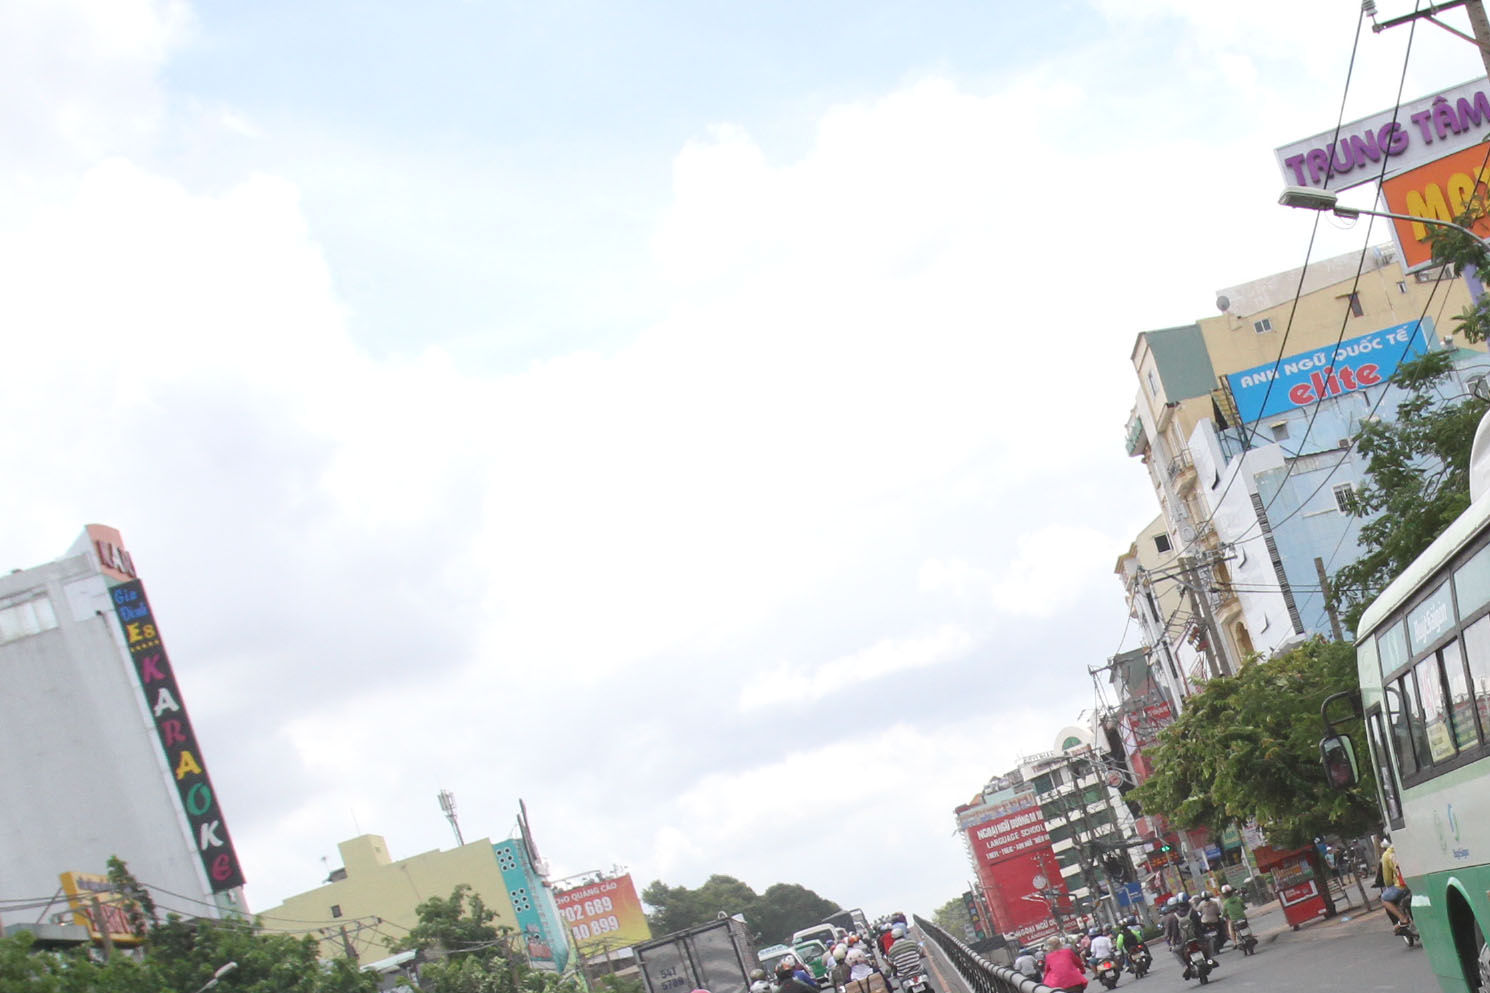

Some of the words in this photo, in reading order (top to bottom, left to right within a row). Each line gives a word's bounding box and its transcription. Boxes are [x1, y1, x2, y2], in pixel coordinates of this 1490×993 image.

[1285, 121, 1409, 187] TRUNG
[1241, 367, 1280, 388] ANH
[1284, 352, 1327, 376] NGỮ
[1331, 336, 1384, 361] QUỐC
[1385, 325, 1409, 346] TẾ
[1288, 363, 1383, 405] elite
[141, 653, 234, 881] KARAOKE
[985, 831, 1020, 849] LANGUAGE
[1020, 823, 1045, 838] SCHOOL
